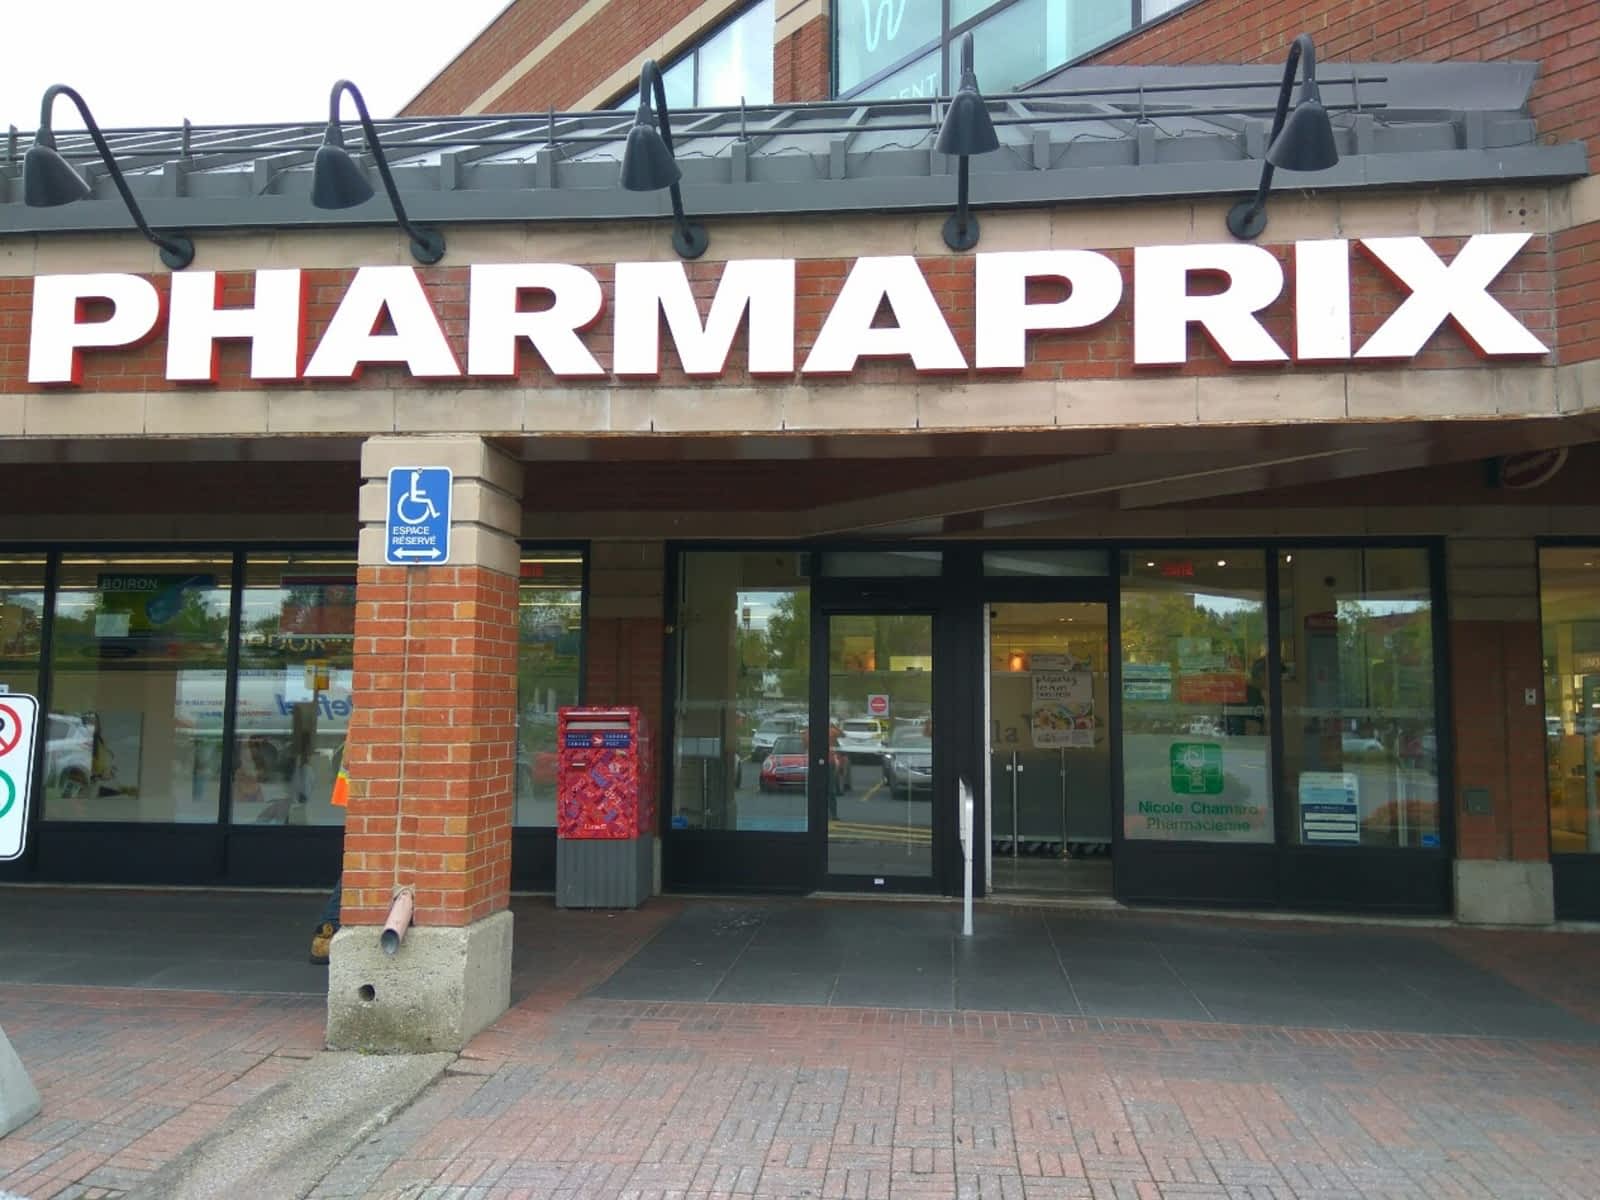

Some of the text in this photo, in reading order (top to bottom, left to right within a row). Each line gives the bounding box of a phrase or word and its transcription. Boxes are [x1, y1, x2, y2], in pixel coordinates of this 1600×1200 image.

[27, 232, 1551, 385] PHARMAPRIX
[392, 526, 430, 535] ESPACE
[102, 578, 158, 590] BOIRON
[1138, 801, 1184, 814] Nicole
[1146, 817, 1250, 832] Pharmacienne
